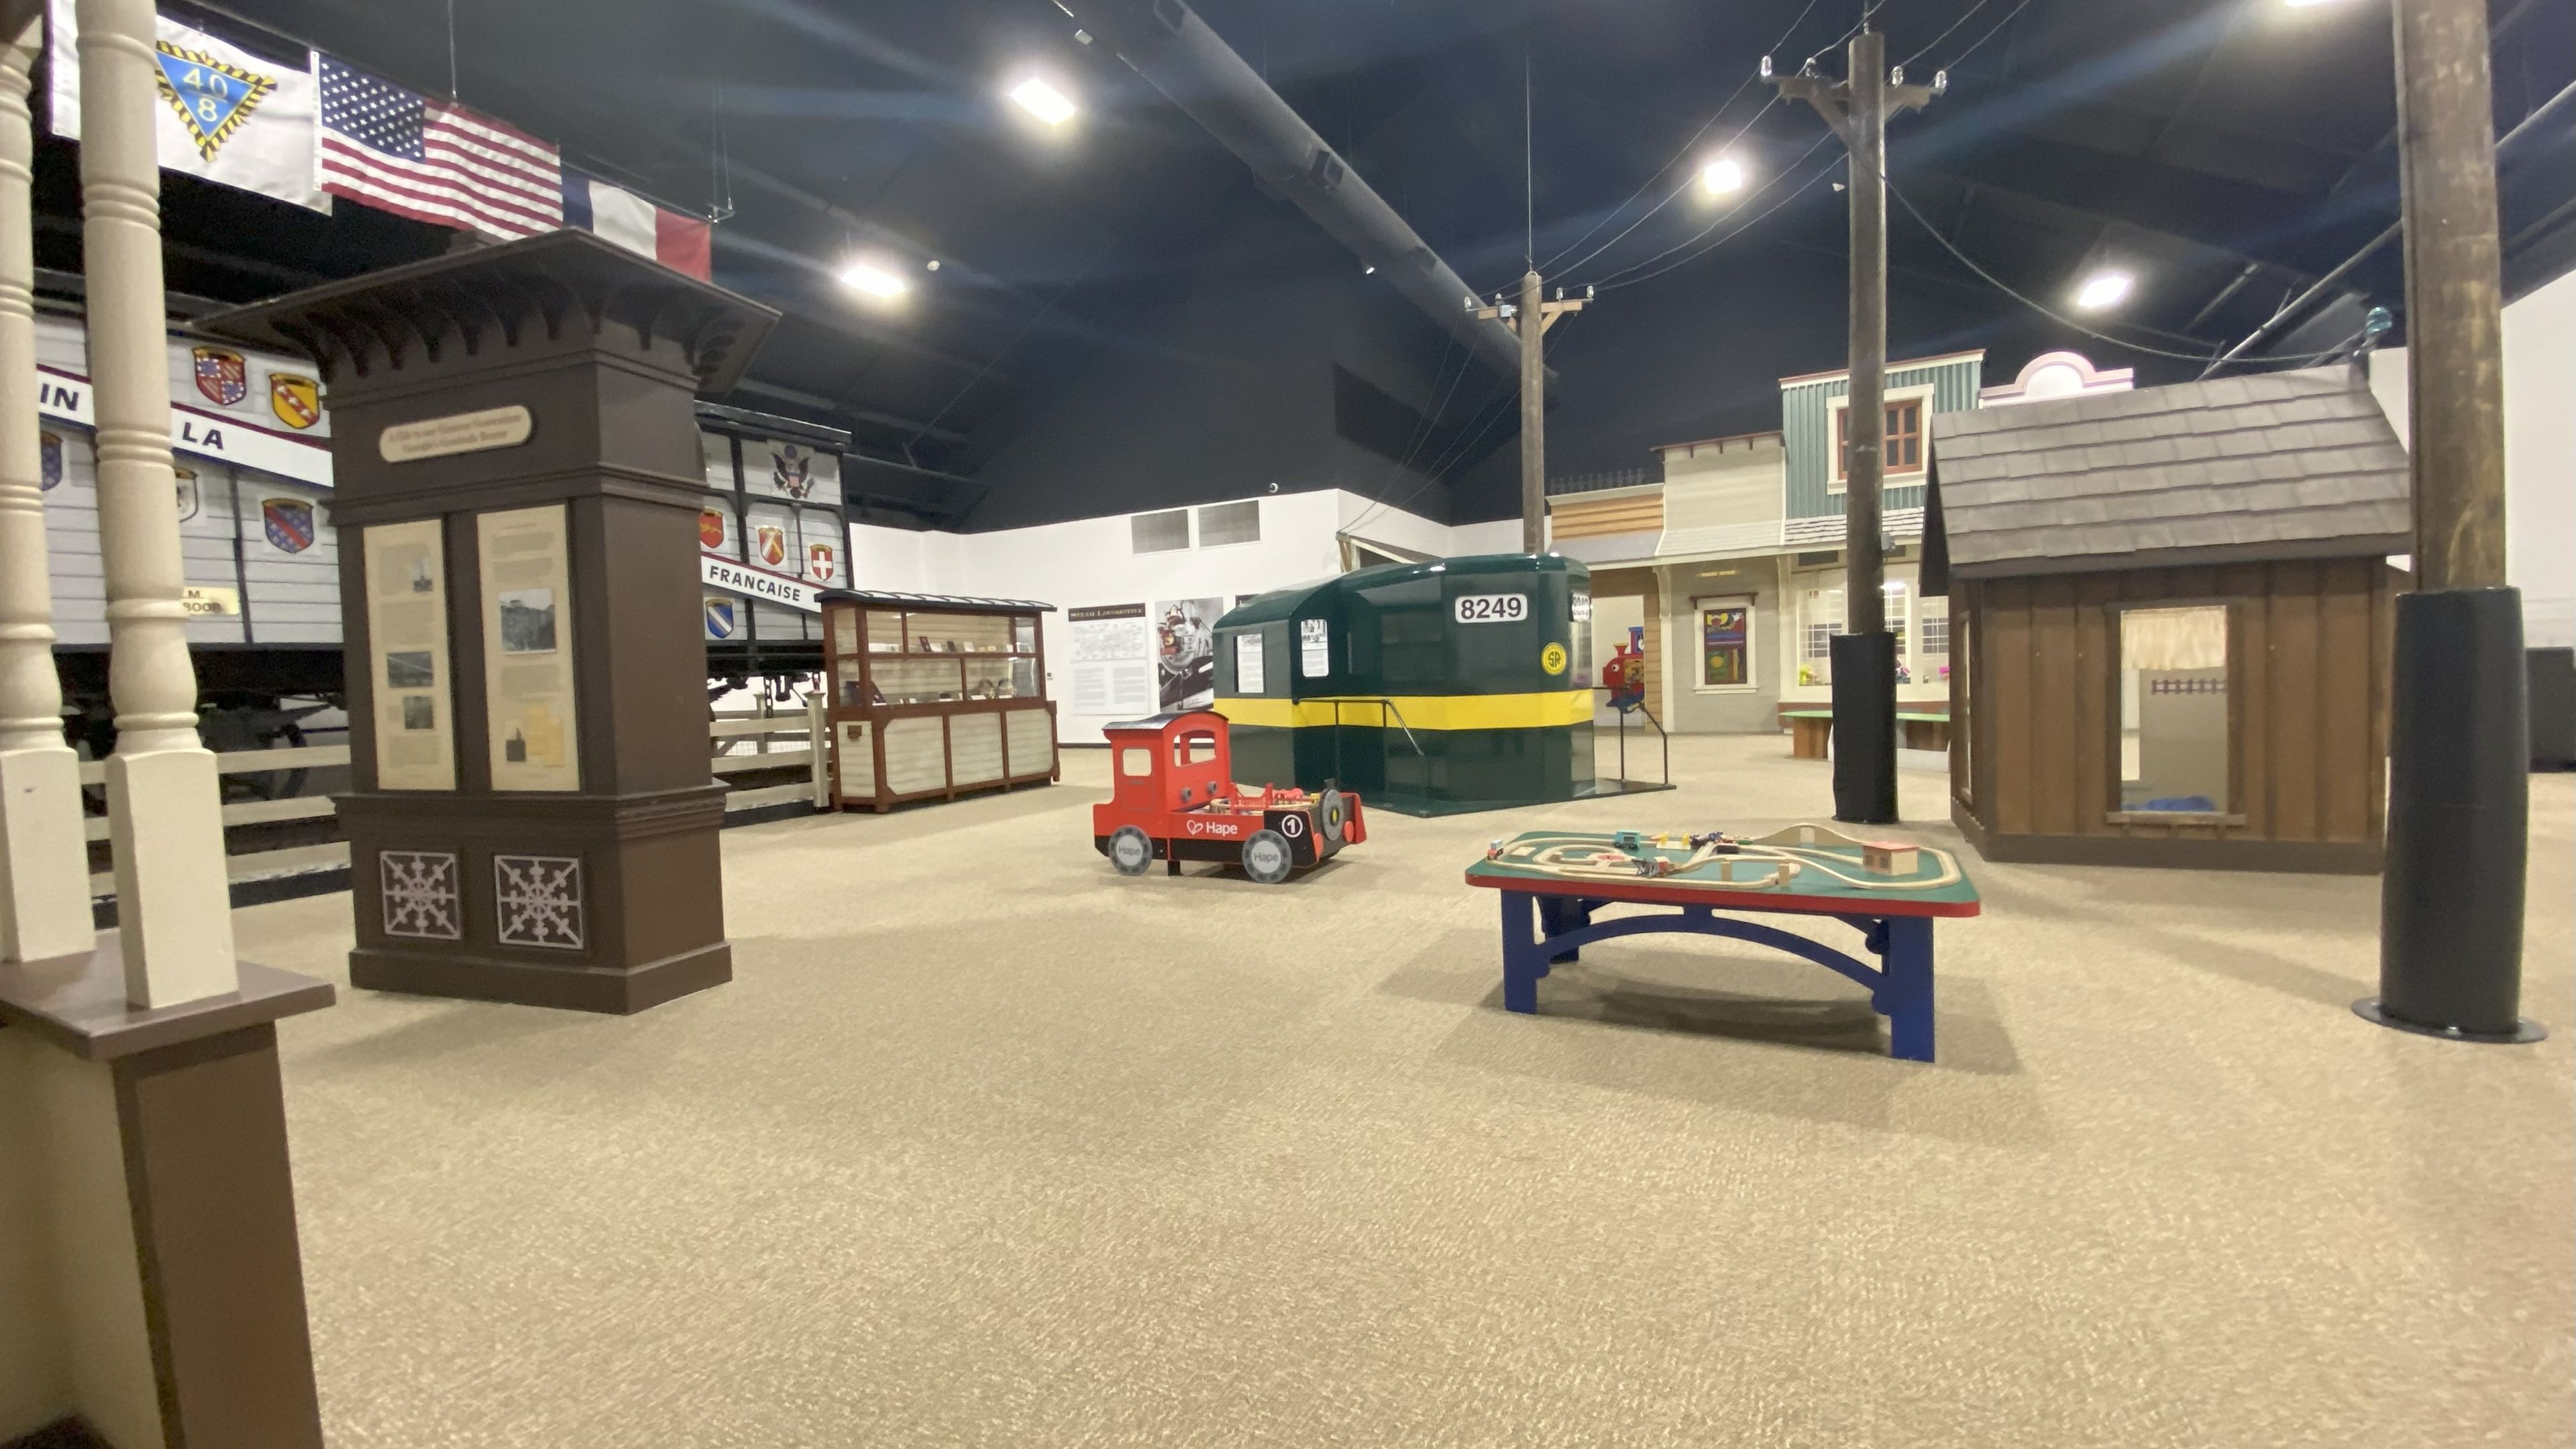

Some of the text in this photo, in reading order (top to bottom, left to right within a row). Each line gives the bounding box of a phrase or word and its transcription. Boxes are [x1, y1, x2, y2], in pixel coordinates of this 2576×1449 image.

[182, 68, 228, 99] 40
[198, 97, 218, 123] 8
[182, 421, 224, 450] LA
[709, 565, 801, 602] FRANCAISE
[1460, 596, 1522, 620] 8249
[1548, 651, 1561, 668] SR
[1205, 821, 1238, 837] Hape
[1287, 818, 1296, 834] 1
[1118, 846, 1141, 856] Hape
[1254, 852, 1279, 863] Hape
